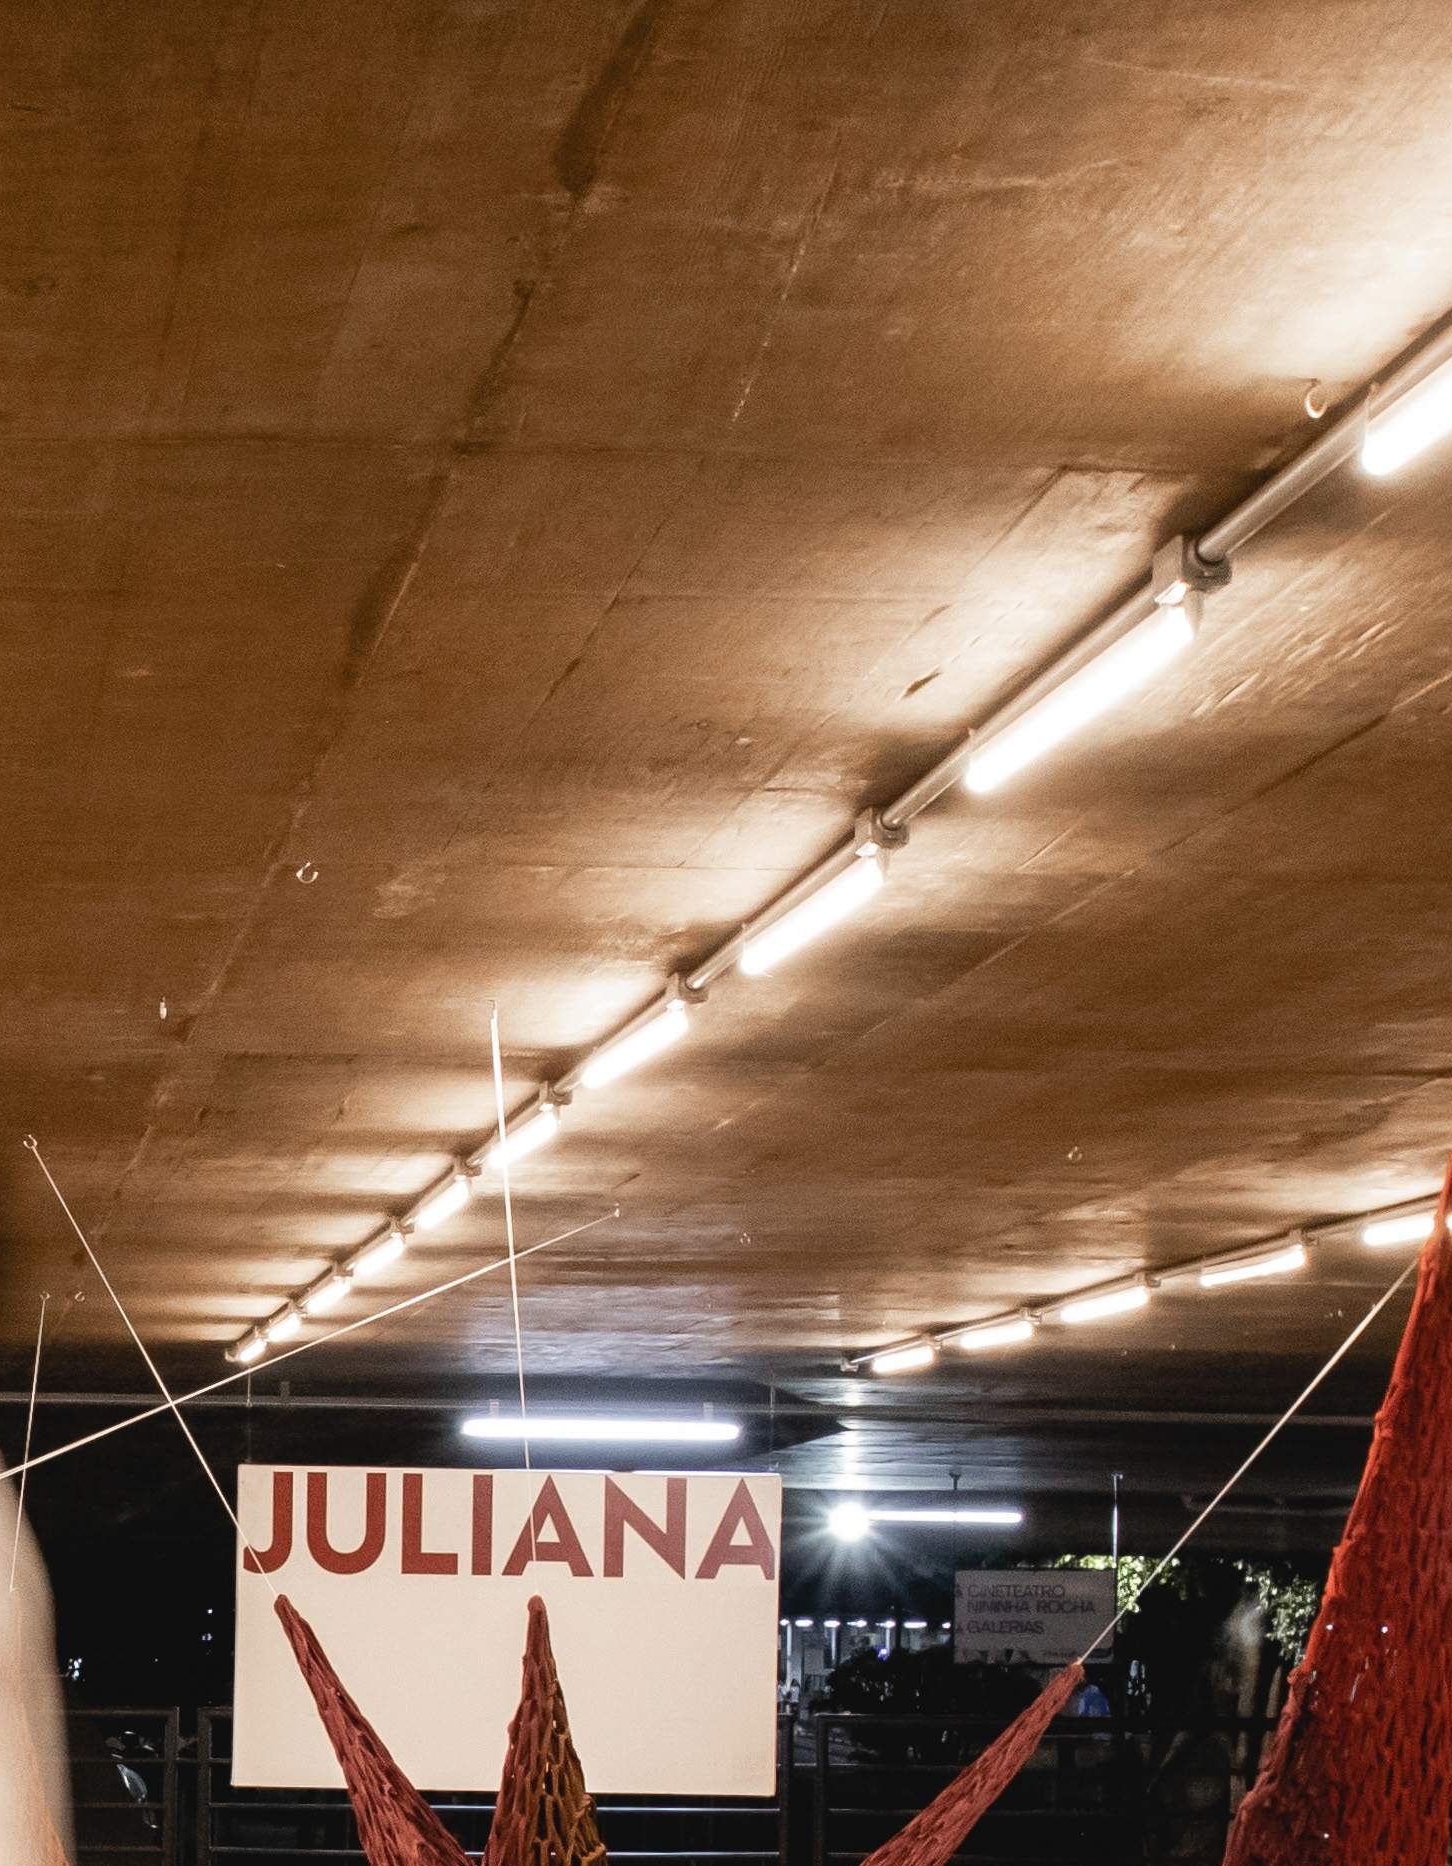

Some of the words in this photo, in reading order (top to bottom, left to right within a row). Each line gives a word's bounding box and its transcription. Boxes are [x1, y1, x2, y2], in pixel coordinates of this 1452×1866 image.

[243, 1471, 775, 1580] JULIANA
[967, 1584, 1066, 1598] CINETEATRO
[1037, 1600, 1095, 1614] ROCHA
[967, 1620, 1044, 1634] GALERIAS
